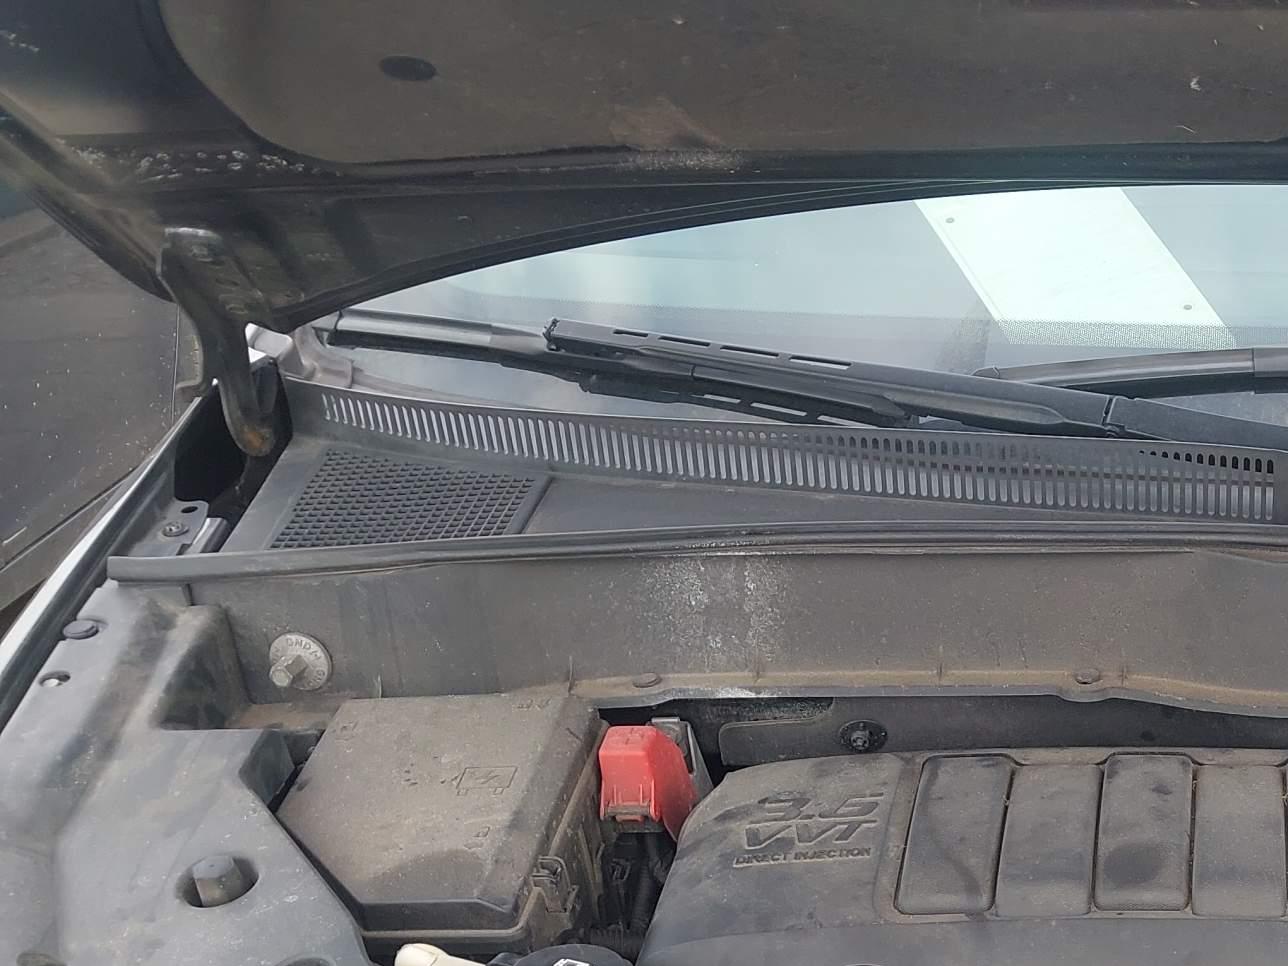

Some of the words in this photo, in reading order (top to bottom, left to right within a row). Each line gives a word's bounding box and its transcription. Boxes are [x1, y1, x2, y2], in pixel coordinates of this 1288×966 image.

[744, 819, 879, 850] VVT
[733, 852, 789, 868] DIRECT
[793, 847, 871, 862] INJECTION
